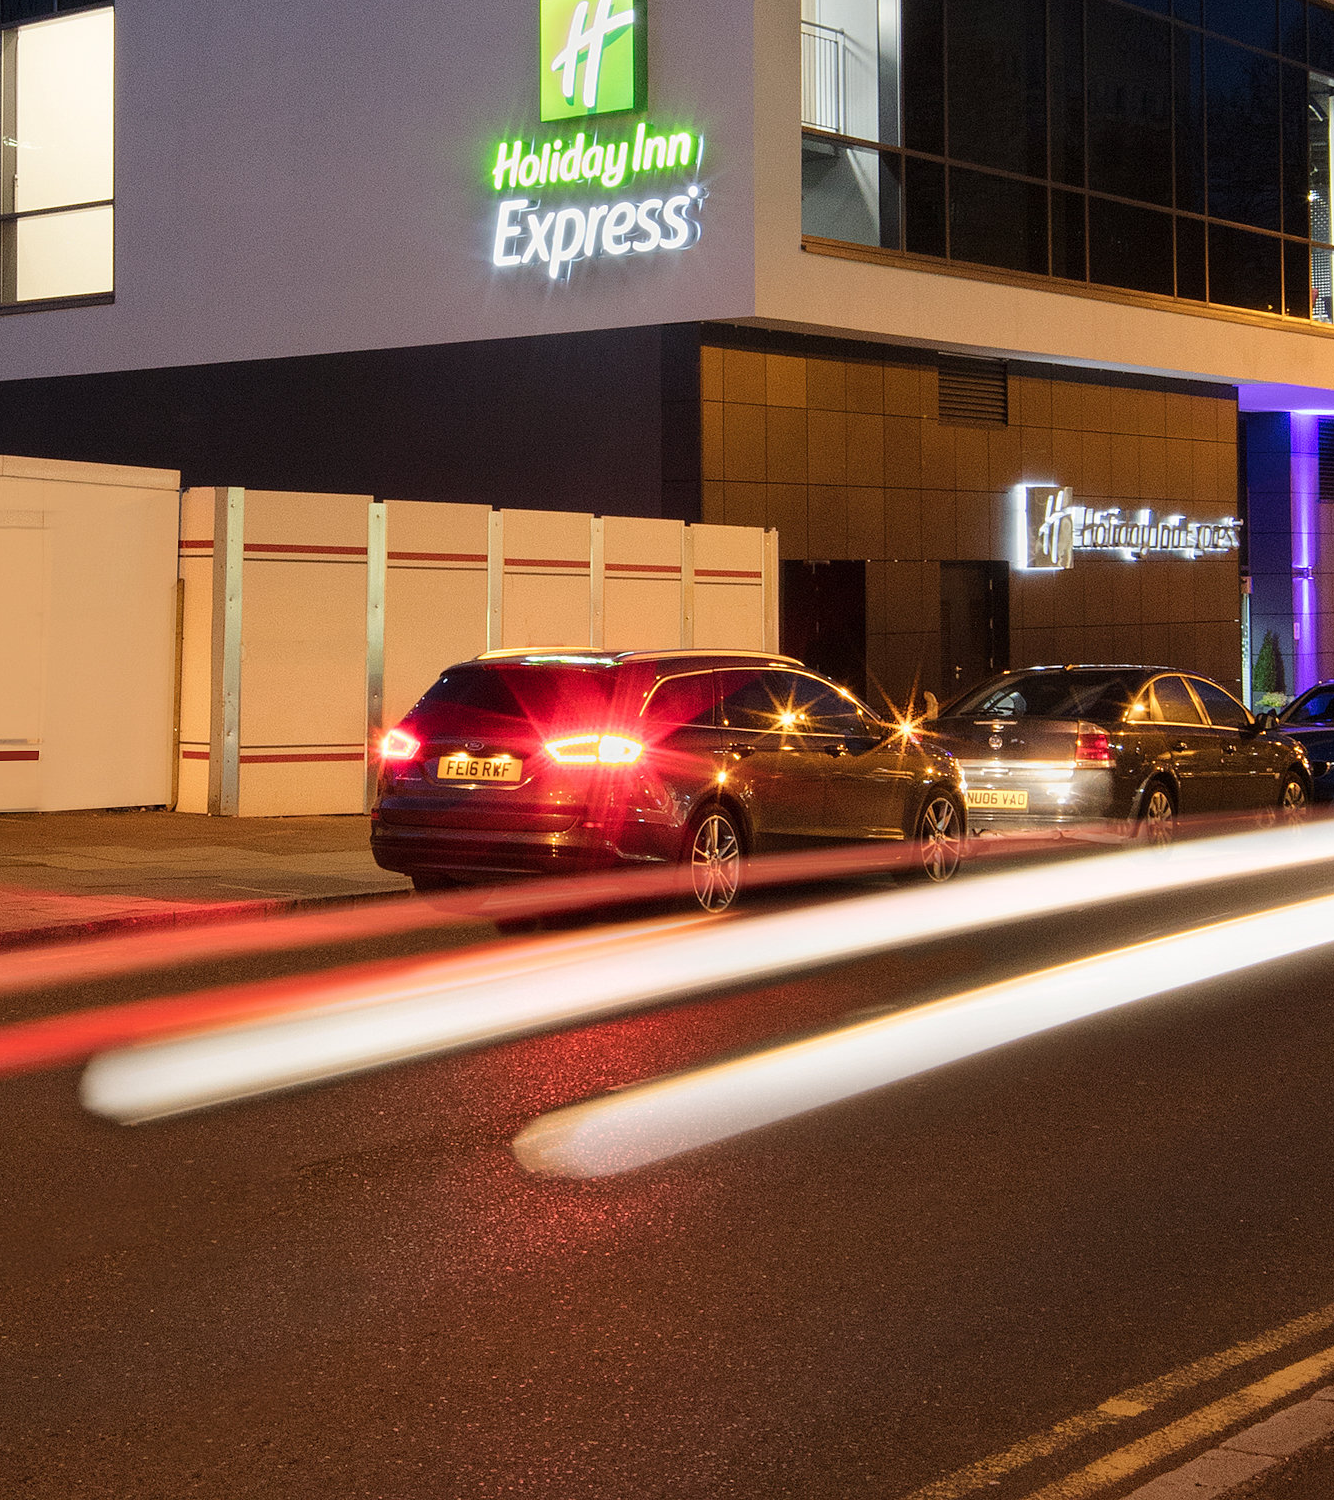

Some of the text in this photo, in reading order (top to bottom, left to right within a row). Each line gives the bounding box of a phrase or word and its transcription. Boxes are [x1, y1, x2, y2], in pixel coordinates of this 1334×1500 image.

[492, 121, 693, 188] Holiday Inn
[492, 196, 692, 280] Express
[446, 760, 479, 776] FE16
[967, 792, 998, 805] NU06
